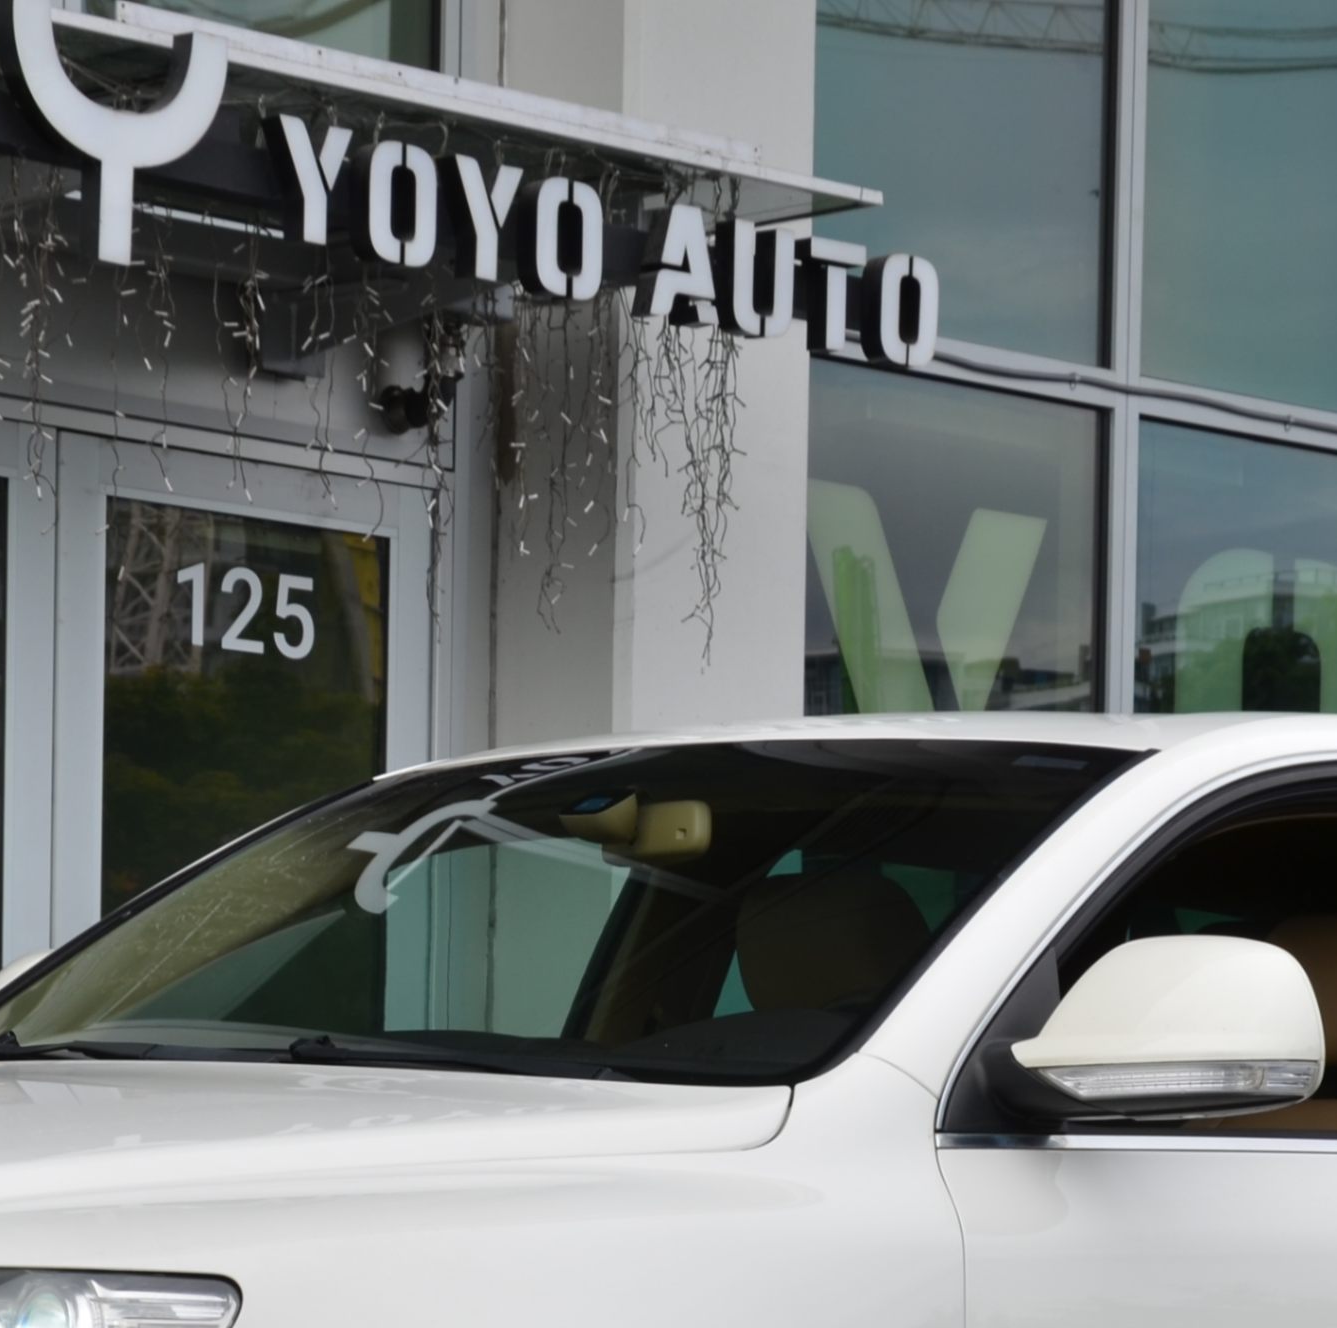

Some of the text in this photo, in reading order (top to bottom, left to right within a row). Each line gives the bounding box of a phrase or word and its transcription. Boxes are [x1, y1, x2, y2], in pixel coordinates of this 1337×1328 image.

[278, 114, 940, 368] YOYO AUTO
[177, 562, 315, 660] 125
